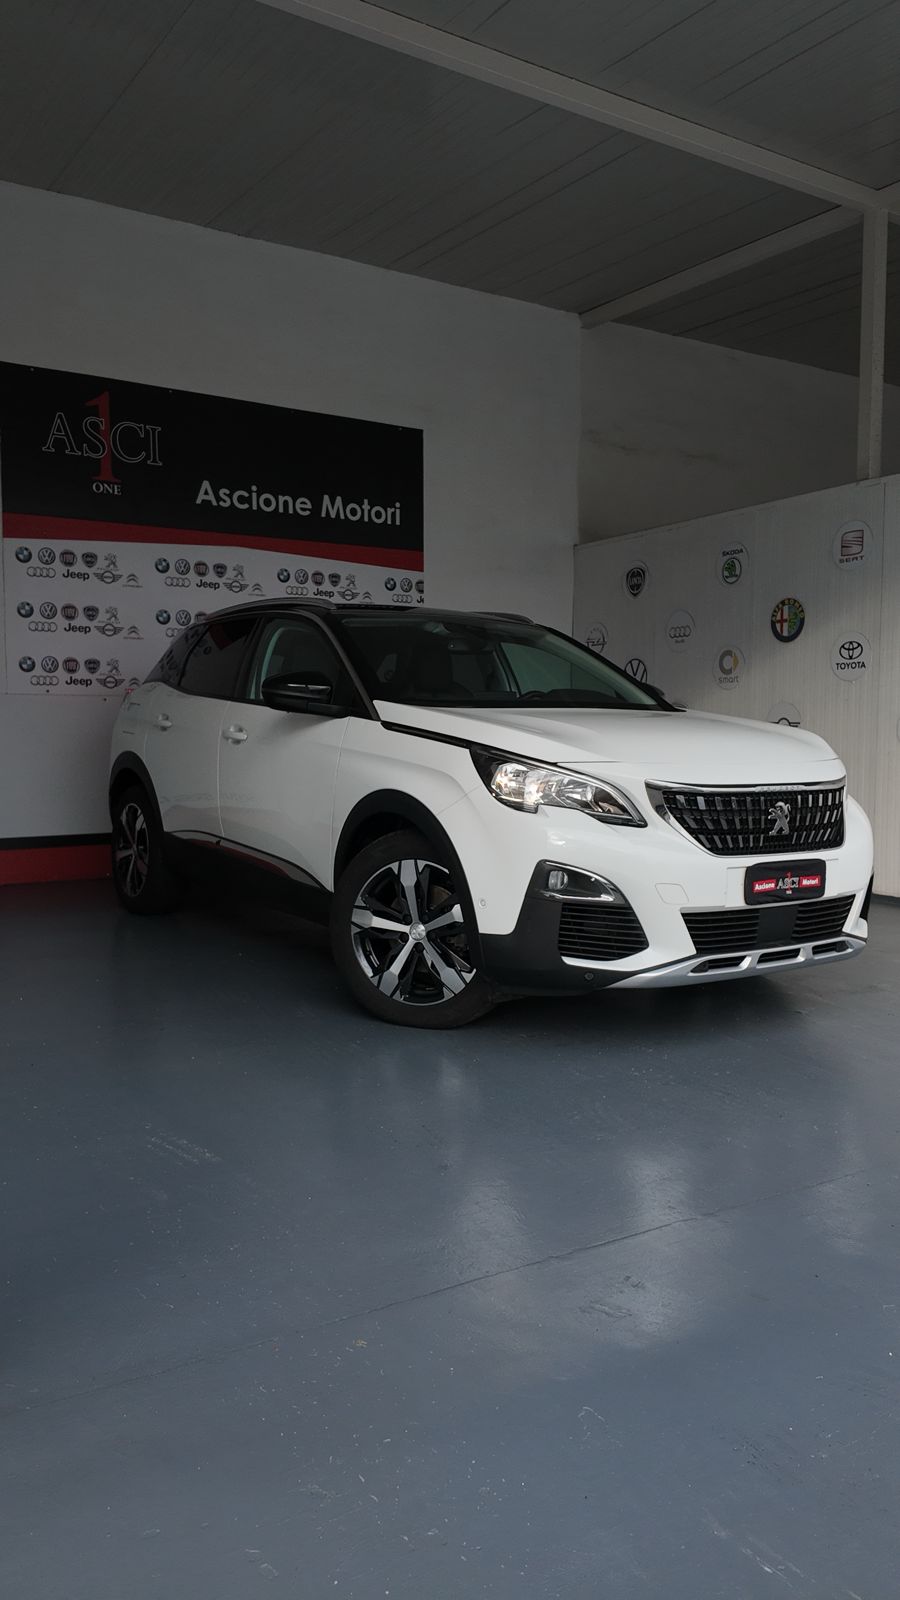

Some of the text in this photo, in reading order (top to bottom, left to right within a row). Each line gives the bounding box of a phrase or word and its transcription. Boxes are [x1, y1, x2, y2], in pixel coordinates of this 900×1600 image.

[42, 411, 163, 466] ASCI
[92, 482, 122, 495] ONE
[195, 480, 401, 526] Ascione Motori
[62, 568, 90, 582] Jeep
[195, 579, 221, 591] Jeep
[313, 588, 335, 600] Jeep
[64, 622, 91, 635] Jeep
[835, 661, 866, 671] TOYOTA
[65, 675, 93, 688] Jeep
[718, 675, 739, 684] smart
